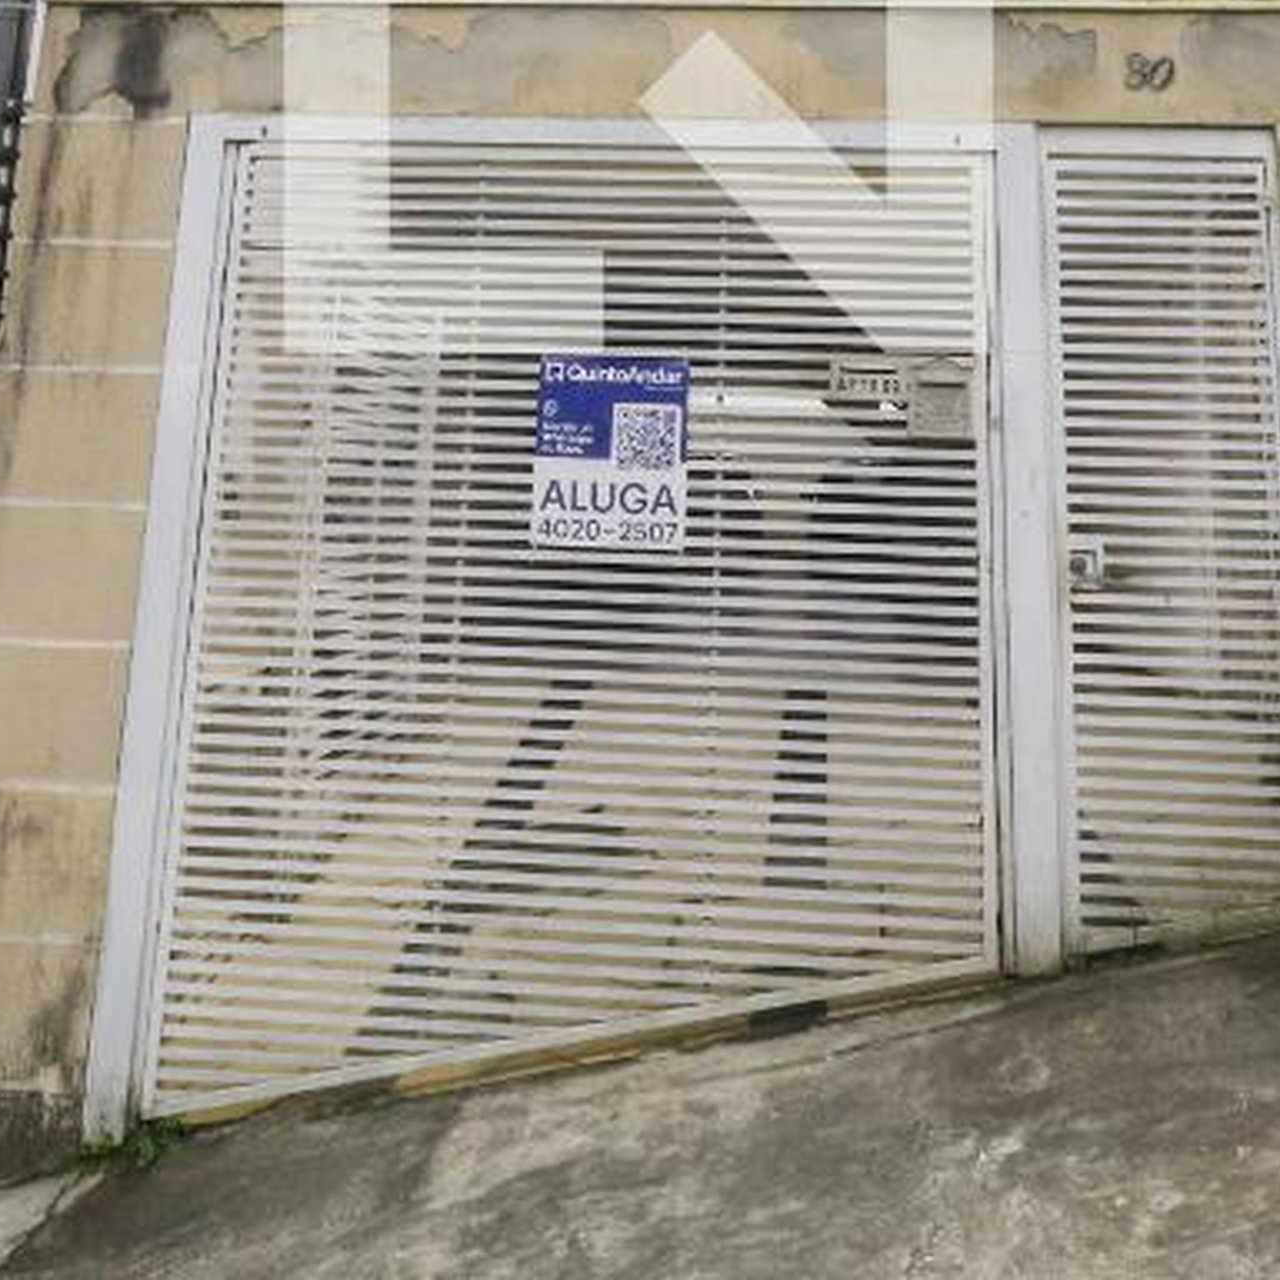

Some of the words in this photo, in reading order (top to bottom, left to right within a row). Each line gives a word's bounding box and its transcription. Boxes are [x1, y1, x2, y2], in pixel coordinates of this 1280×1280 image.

[1123, 52, 1175, 93] 80
[567, 364, 684, 384] QuintoAndar
[540, 479, 678, 516] ALUGA
[537, 519, 678, 545] 4020-2507
